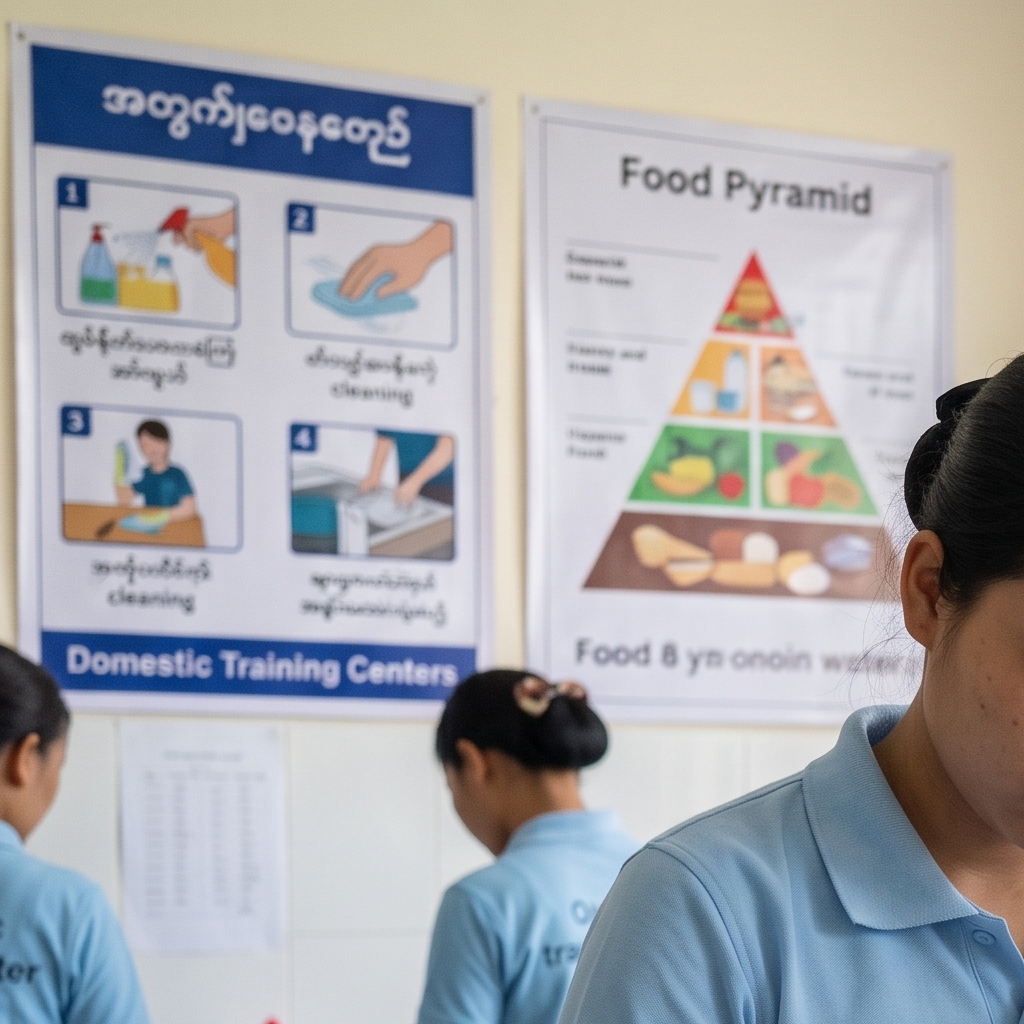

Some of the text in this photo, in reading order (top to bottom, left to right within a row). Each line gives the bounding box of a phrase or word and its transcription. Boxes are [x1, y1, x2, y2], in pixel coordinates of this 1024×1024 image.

[68, 182, 78, 203] 1
[620, 156, 873, 217] Food Pyramid
[293, 207, 309, 230] 2
[67, 409, 85, 433] 3
[294, 426, 311, 449] 4
[575, 638, 652, 667] Food
[66, 644, 459, 689] Domestic Training Centers
